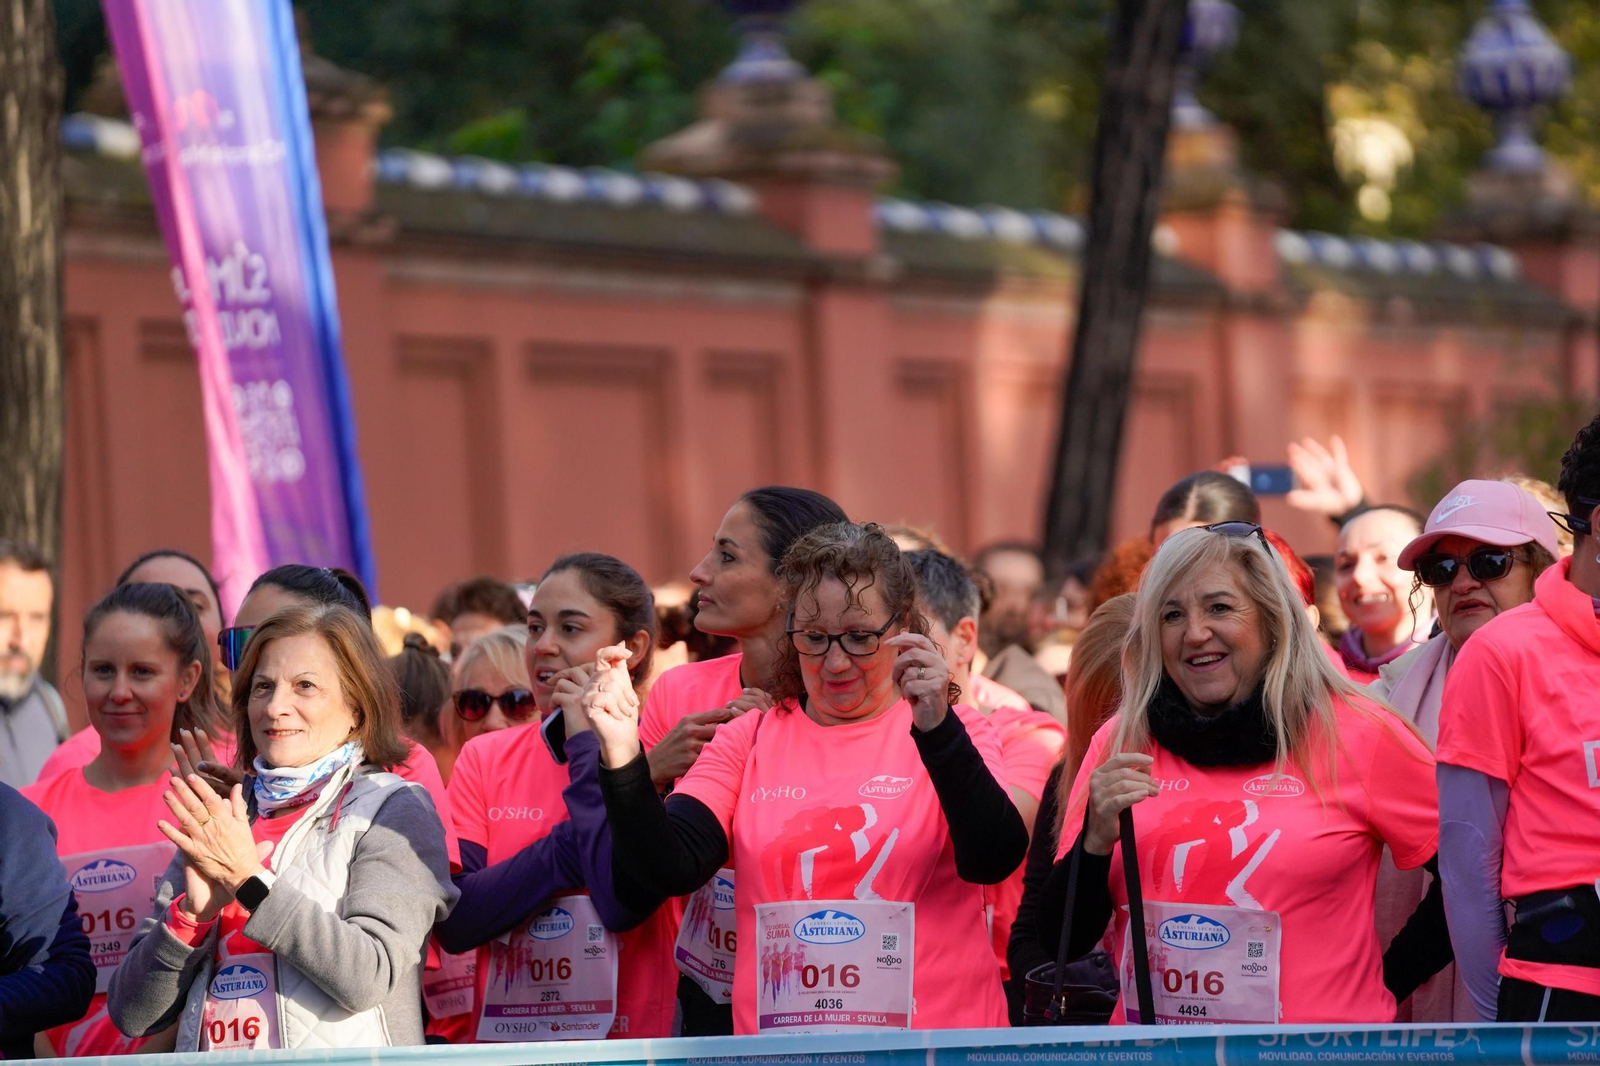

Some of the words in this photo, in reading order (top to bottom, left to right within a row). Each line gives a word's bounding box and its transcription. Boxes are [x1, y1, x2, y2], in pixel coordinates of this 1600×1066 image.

[74, 871, 131, 888] ASTURIANA
[80, 907, 136, 935] 016
[531, 920, 570, 934] ASTURIANA
[766, 930, 791, 940] SUMA
[799, 923, 860, 937] ASTURIANA
[1161, 925, 1225, 943] ASTURIANA
[530, 957, 572, 982] 016
[801, 964, 860, 989] 016
[1163, 968, 1225, 996] 016
[212, 980, 264, 994] ASTURIANA
[540, 990, 560, 1002] 2872
[502, 1006, 530, 1015] CARRERA
[531, 1006, 539, 1014] DE
[571, 1004, 596, 1012] SEVILLA
[814, 998, 843, 1010] 4036
[1178, 1004, 1207, 1017] 4494
[773, 1015, 802, 1025] CARRERA
[804, 1014, 812, 1022] DE
[814, 1014, 822, 1022] LA
[824, 1013, 851, 1022] MUJER
[857, 1014, 887, 1024] SEVILLA
[210, 1016, 260, 1044] 016
[494, 1022, 537, 1034] OYSHO
[561, 1022, 601, 1032] Santander
[823, 1054, 865, 1064] EVENTOS
[1023, 1050, 1098, 1062] COMUNICACIÓN
[1100, 1052, 1106, 1061] Y
[1107, 1052, 1153, 1061] EVENTOS
[1318, 1050, 1396, 1062] COMUNICACIÓN
[1398, 1052, 1404, 1061] Y
[1407, 1052, 1455, 1062] EVENTOS
[1567, 1052, 1600, 1061] MOVIL
